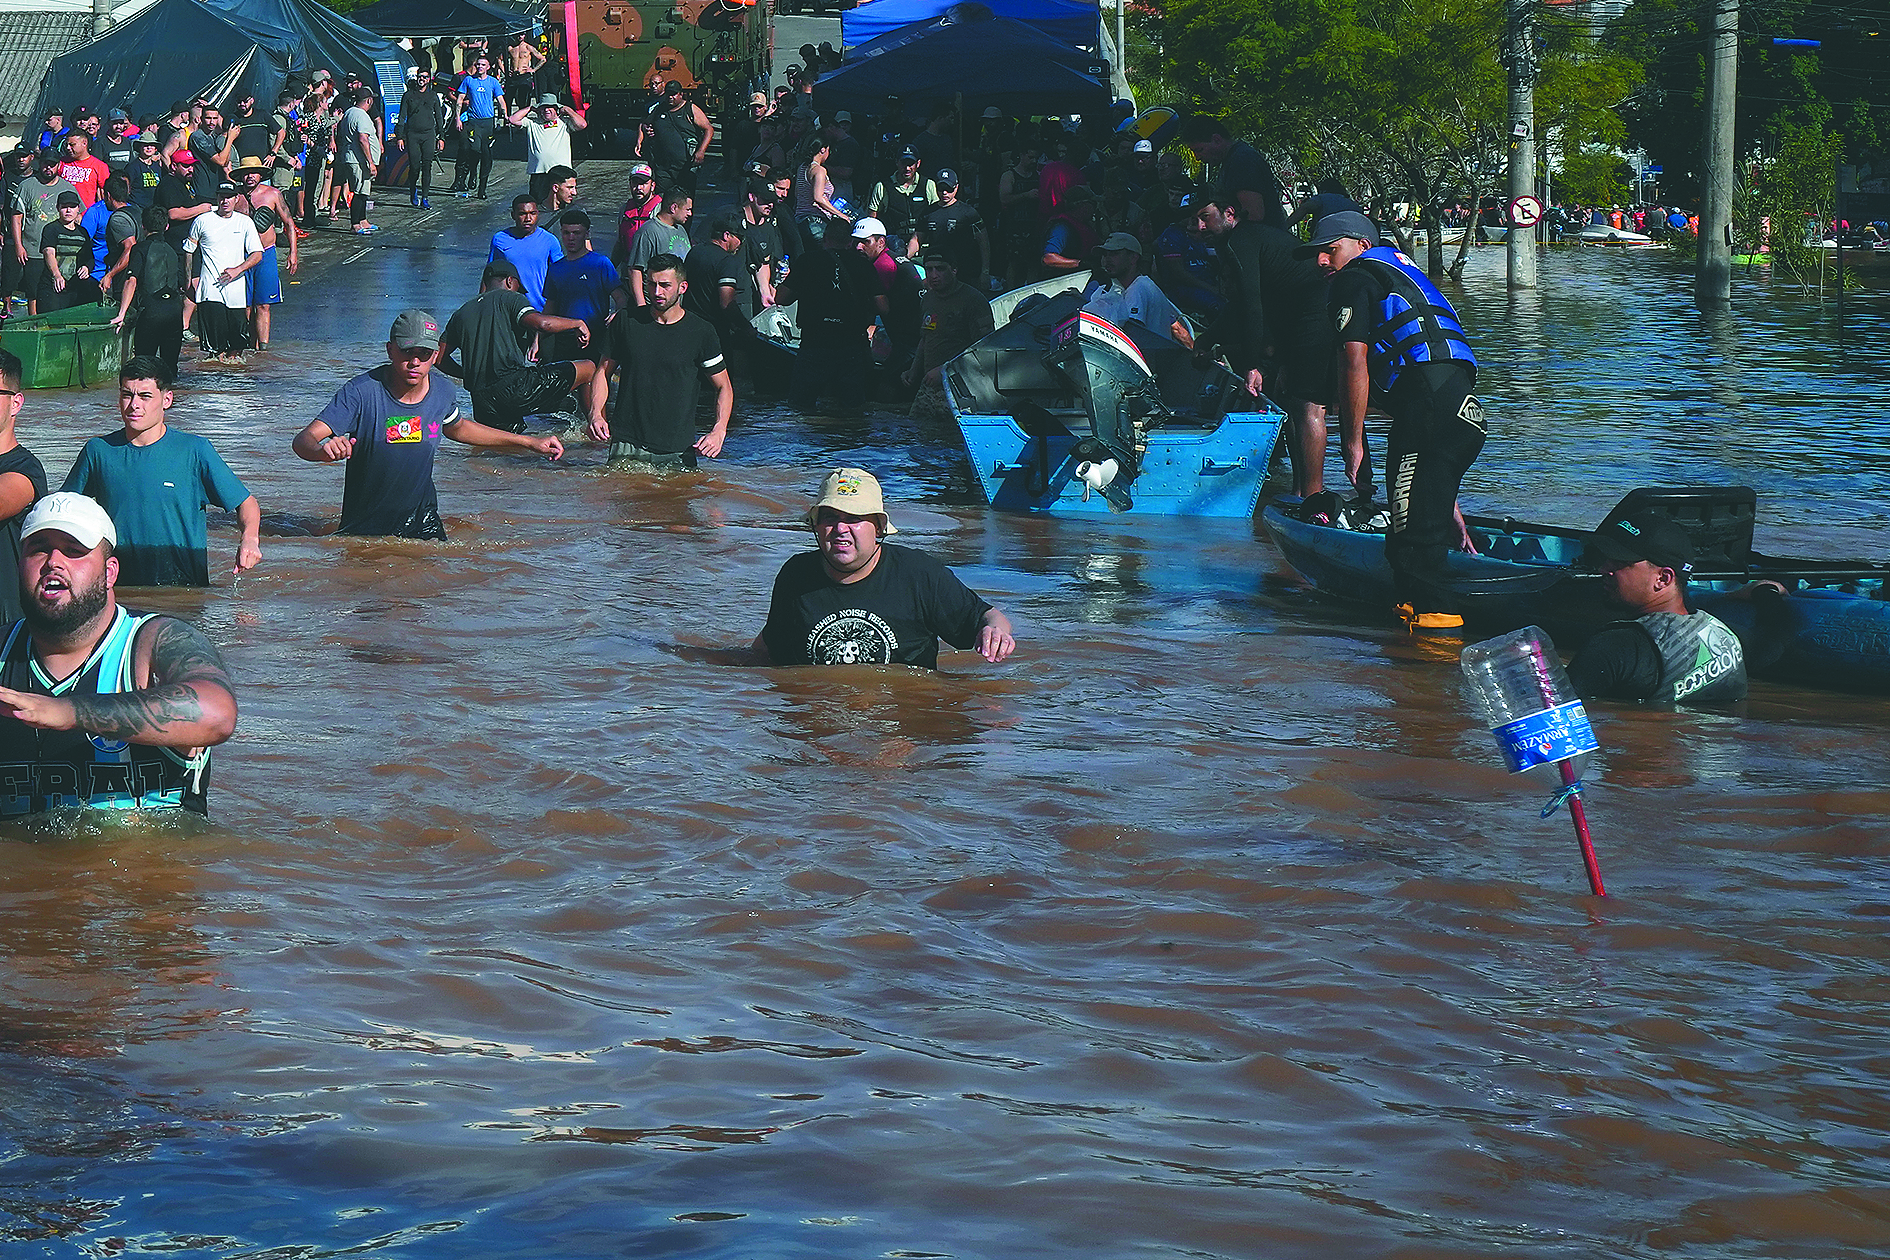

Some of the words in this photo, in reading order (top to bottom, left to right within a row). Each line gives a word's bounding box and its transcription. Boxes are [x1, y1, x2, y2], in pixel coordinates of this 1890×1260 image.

[1090, 325, 1119, 344] YAMAHA
[838, 608, 868, 619] NOISE
[867, 612, 899, 650] RECORDS
